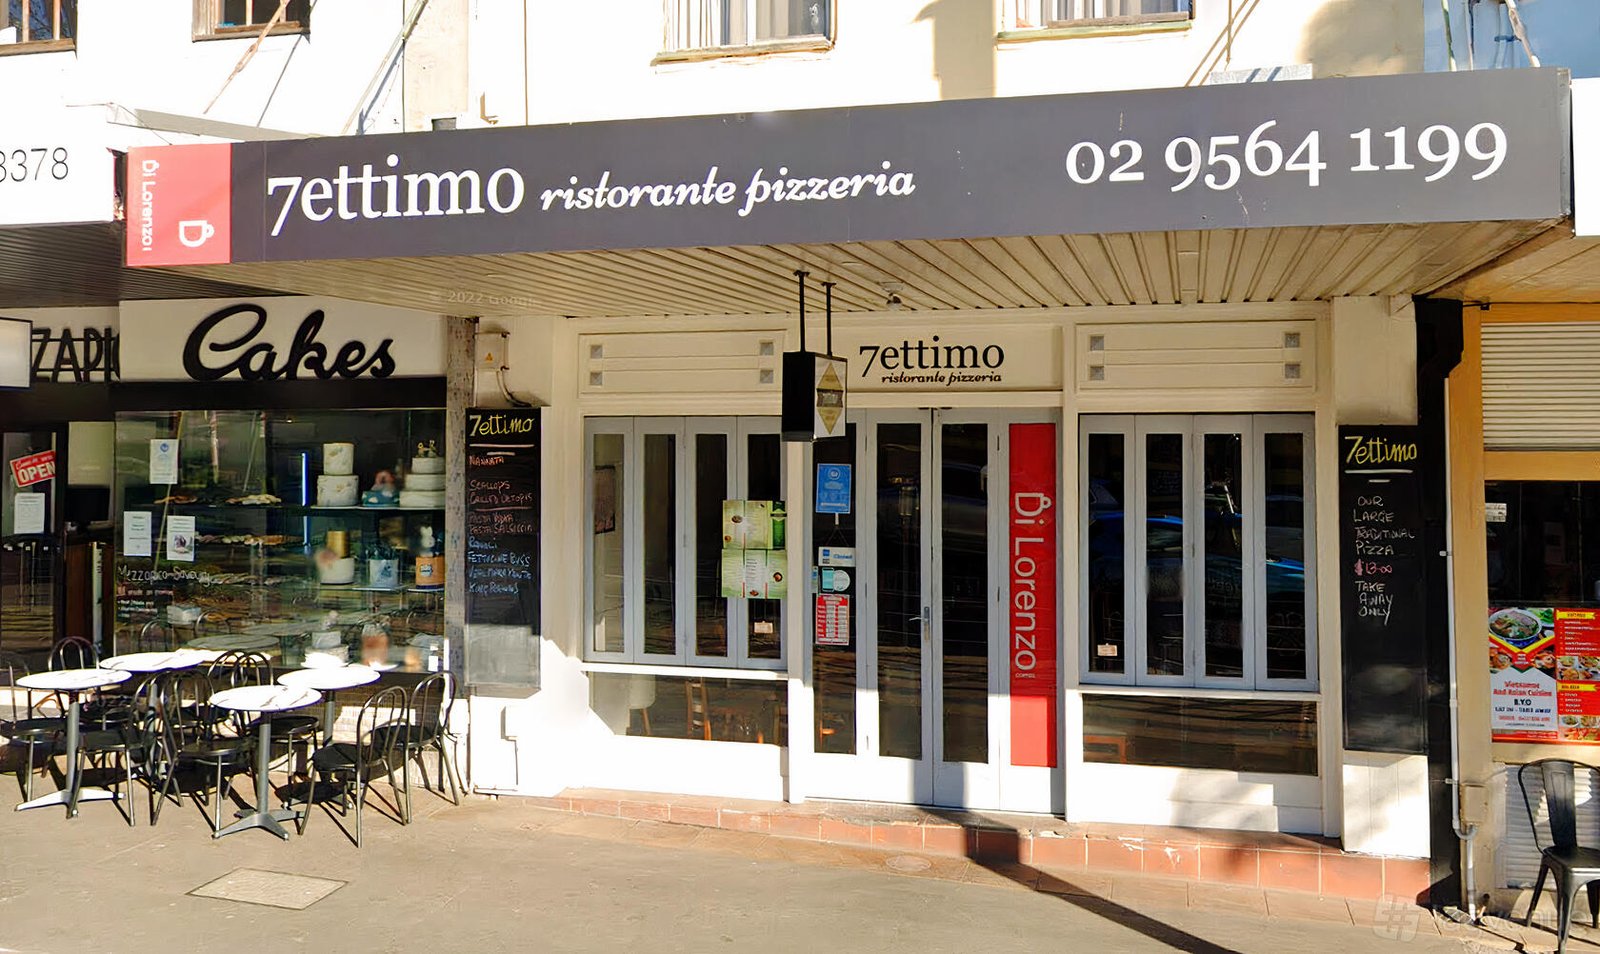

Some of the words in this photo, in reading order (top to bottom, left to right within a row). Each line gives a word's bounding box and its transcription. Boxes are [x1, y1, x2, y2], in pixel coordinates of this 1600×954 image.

[1066, 139, 1145, 184] 02
[1164, 119, 1327, 192] 9564
[1350, 122, 1507, 182] 1199
[267, 153, 525, 237] 7ettimo
[540, 166, 737, 211] ristorante
[737, 160, 916, 217] pizzeria
[142, 180, 156, 246] Lorenzo
[182, 303, 397, 381] Cakes
[859, 335, 1005, 380] 7ettimo
[881, 371, 946, 384] ristorante
[946, 371, 1002, 388] pizzeria
[468, 413, 535, 437] 7ettimo
[1344, 436, 1418, 465] 7ettimo
[17, 460, 56, 484] OPEN
[1353, 509, 1395, 523] LARGE
[1357, 496, 1384, 507] OUR
[1354, 580, 1386, 593] TAKE
[1014, 537, 1044, 671] Lorenzo
